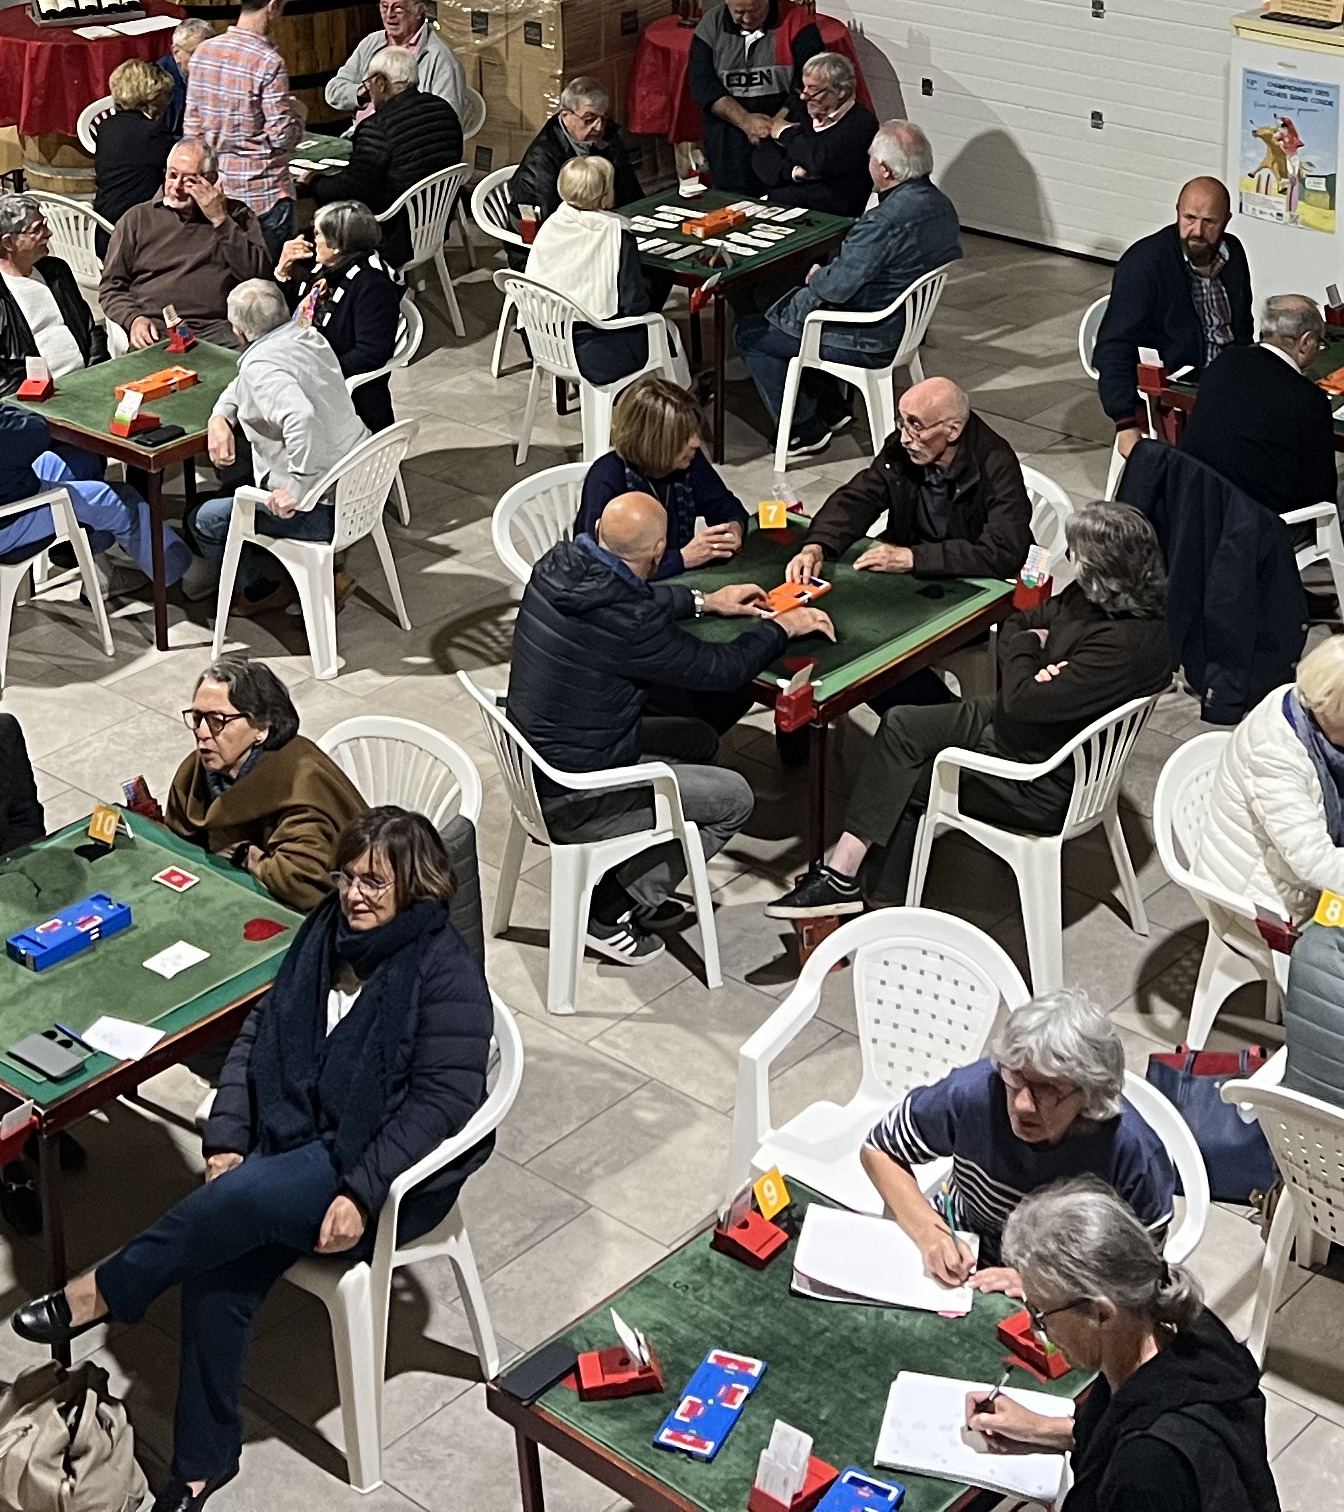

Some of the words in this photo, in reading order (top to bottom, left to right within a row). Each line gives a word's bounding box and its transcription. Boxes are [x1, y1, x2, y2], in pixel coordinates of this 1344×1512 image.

[766, 505, 778, 522] 7
[95, 810, 117, 836] 10
[1325, 899, 1343, 922] 8
[763, 1179, 778, 1207] 9
